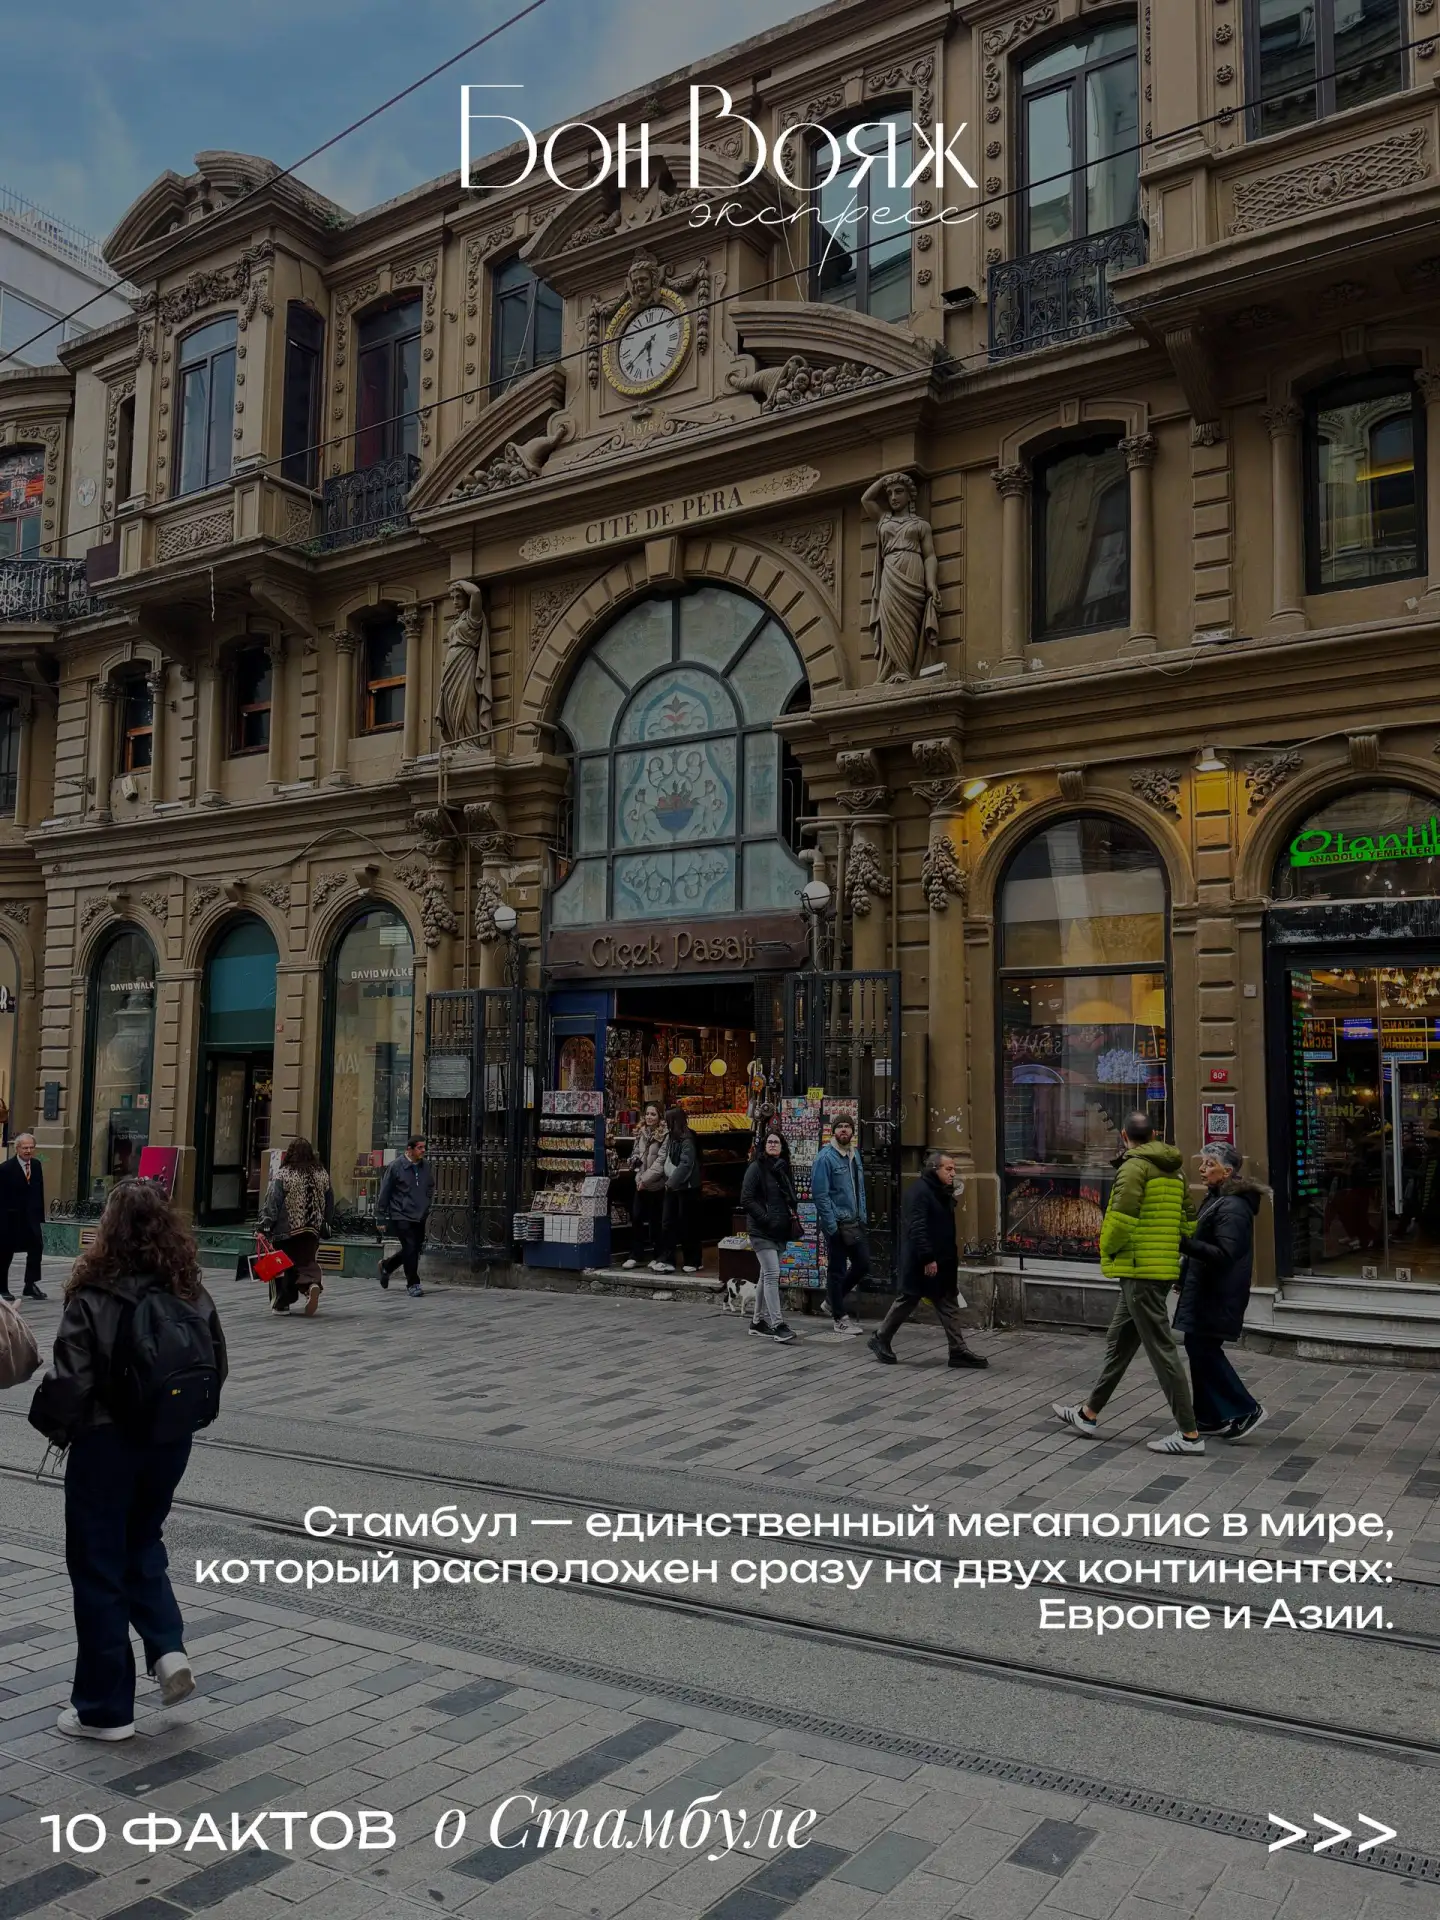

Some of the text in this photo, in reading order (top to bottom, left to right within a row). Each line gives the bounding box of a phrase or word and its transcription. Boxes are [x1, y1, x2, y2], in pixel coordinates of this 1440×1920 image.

[645, 503, 675, 530] DE
[1307, 851, 1365, 864] ANADOLU
[351, 969, 379, 980] DAVID
[110, 982, 133, 992] DAVID
